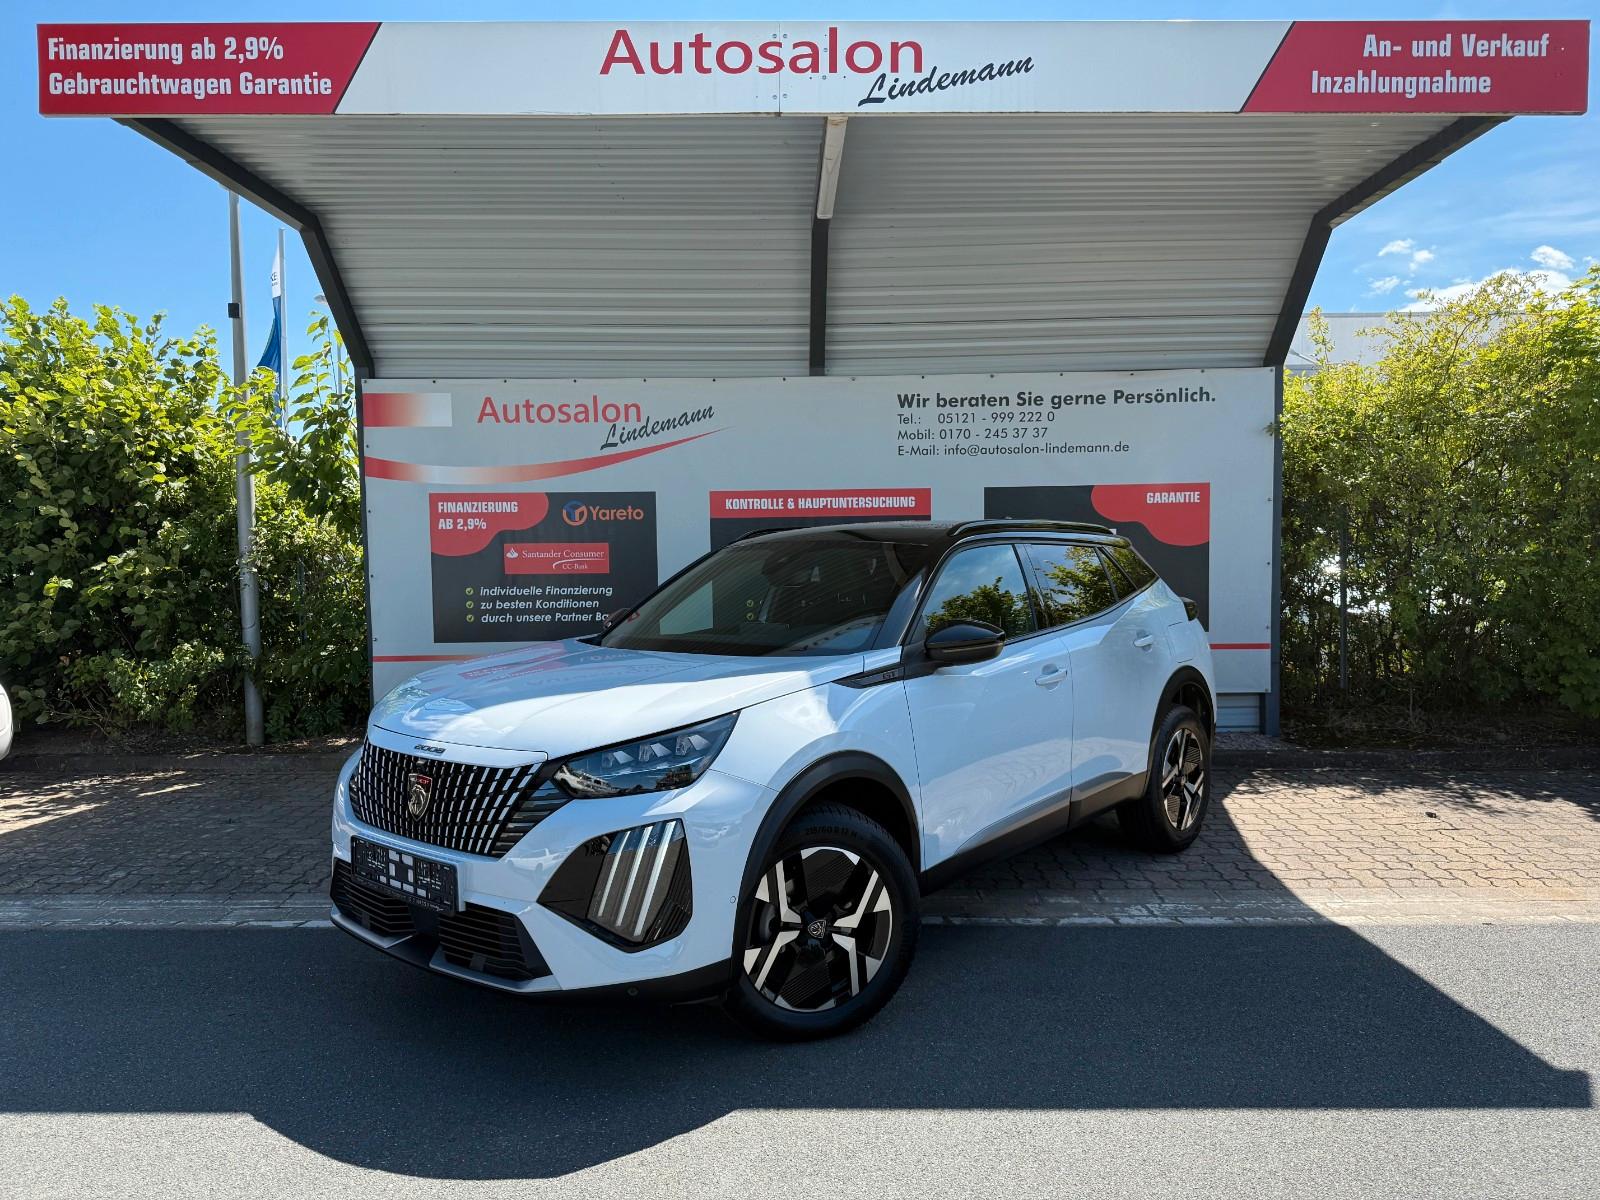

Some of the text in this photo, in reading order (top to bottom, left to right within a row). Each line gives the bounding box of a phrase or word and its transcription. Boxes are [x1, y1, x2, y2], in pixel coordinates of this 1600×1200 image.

[48, 36, 284, 65] Finanzierung ab 2,9%
[599, 26, 923, 75] Autosalon
[1363, 33, 1550, 57] An- und Verkauf
[49, 71, 333, 100] Gebrauchtwagen Garantie
[857, 55, 1035, 107] Lindemann
[1311, 69, 1492, 99] Inzahlungnahme
[897, 386, 1217, 410] Wir beraten Sie gerne Persönlich.
[477, 394, 642, 424] Autosalon
[897, 412, 921, 425] Tel.:
[937, 412, 976, 424] 05121
[991, 411, 1015, 423] 999
[1019, 411, 1043, 422] 222
[1047, 411, 1056, 422] 0
[600, 405, 715, 451] Lindemann
[897, 428, 935, 441] Mobil:
[939, 428, 971, 440] 0170
[984, 427, 1008, 439] 245
[1012, 427, 1028, 439] 37
[1032, 427, 1048, 439] 37
[897, 441, 1130, 457] E-Mail: info@autosalon-lindemann.de
[725, 496, 916, 510] KONTROLLE & HAUPTUNTERSUCHUNG
[1146, 491, 1201, 504] GARANTIE
[438, 500, 519, 514] FINANZIERUNG
[589, 504, 645, 521] Yareto
[438, 518, 487, 531] AB 2,9%
[522, 549, 605, 559] Santander Consumer
[480, 585, 614, 597] individuelle Finanzierung
[480, 599, 600, 610] zu besten Konditionen
[481, 613, 513, 623] durch
[516, 614, 551, 622] unsere
[555, 612, 592, 622] Partner
[414, 744, 447, 754] 2008
